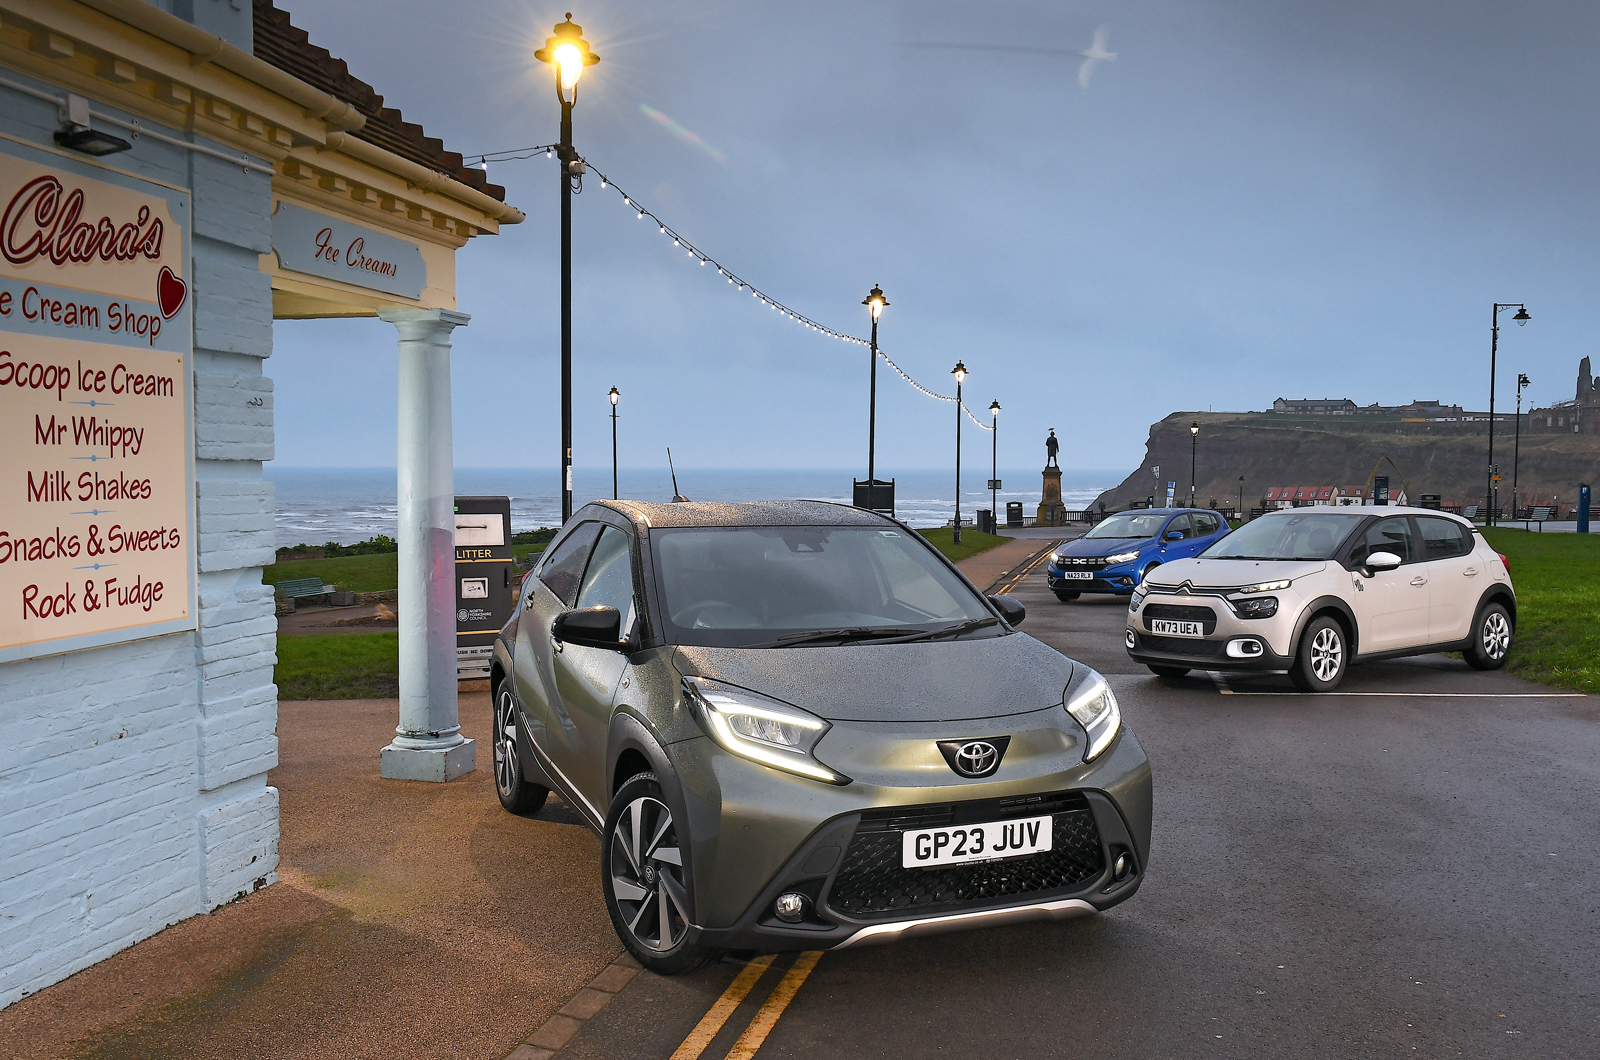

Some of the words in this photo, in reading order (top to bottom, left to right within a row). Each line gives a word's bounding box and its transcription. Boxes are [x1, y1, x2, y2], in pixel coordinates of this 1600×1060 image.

[0, 175, 164, 265] Clara's
[315, 227, 340, 263] Ice
[345, 237, 397, 277] Creams
[22, 286, 99, 328] Cream
[107, 302, 161, 346] Shop
[0, 351, 70, 401] Scoop
[78, 360, 106, 393] Ice
[111, 363, 173, 397] Cream
[35, 414, 67, 445] Mr
[72, 415, 144, 458] Whippy
[27, 471, 72, 502] Milk
[78, 471, 151, 502] Shakes
[0, 527, 81, 564] Snacks
[87, 524, 105, 557] &
[108, 524, 180, 554] Sweets
[456, 549, 492, 559] LITTER
[22, 582, 77, 620] Rock
[83, 579, 101, 612] &
[105, 575, 164, 613] Fudge
[1154, 621, 1178, 633] KW73
[1180, 622, 1198, 635] UEA
[915, 828, 985, 860] GP23
[992, 821, 1041, 851] JUV
